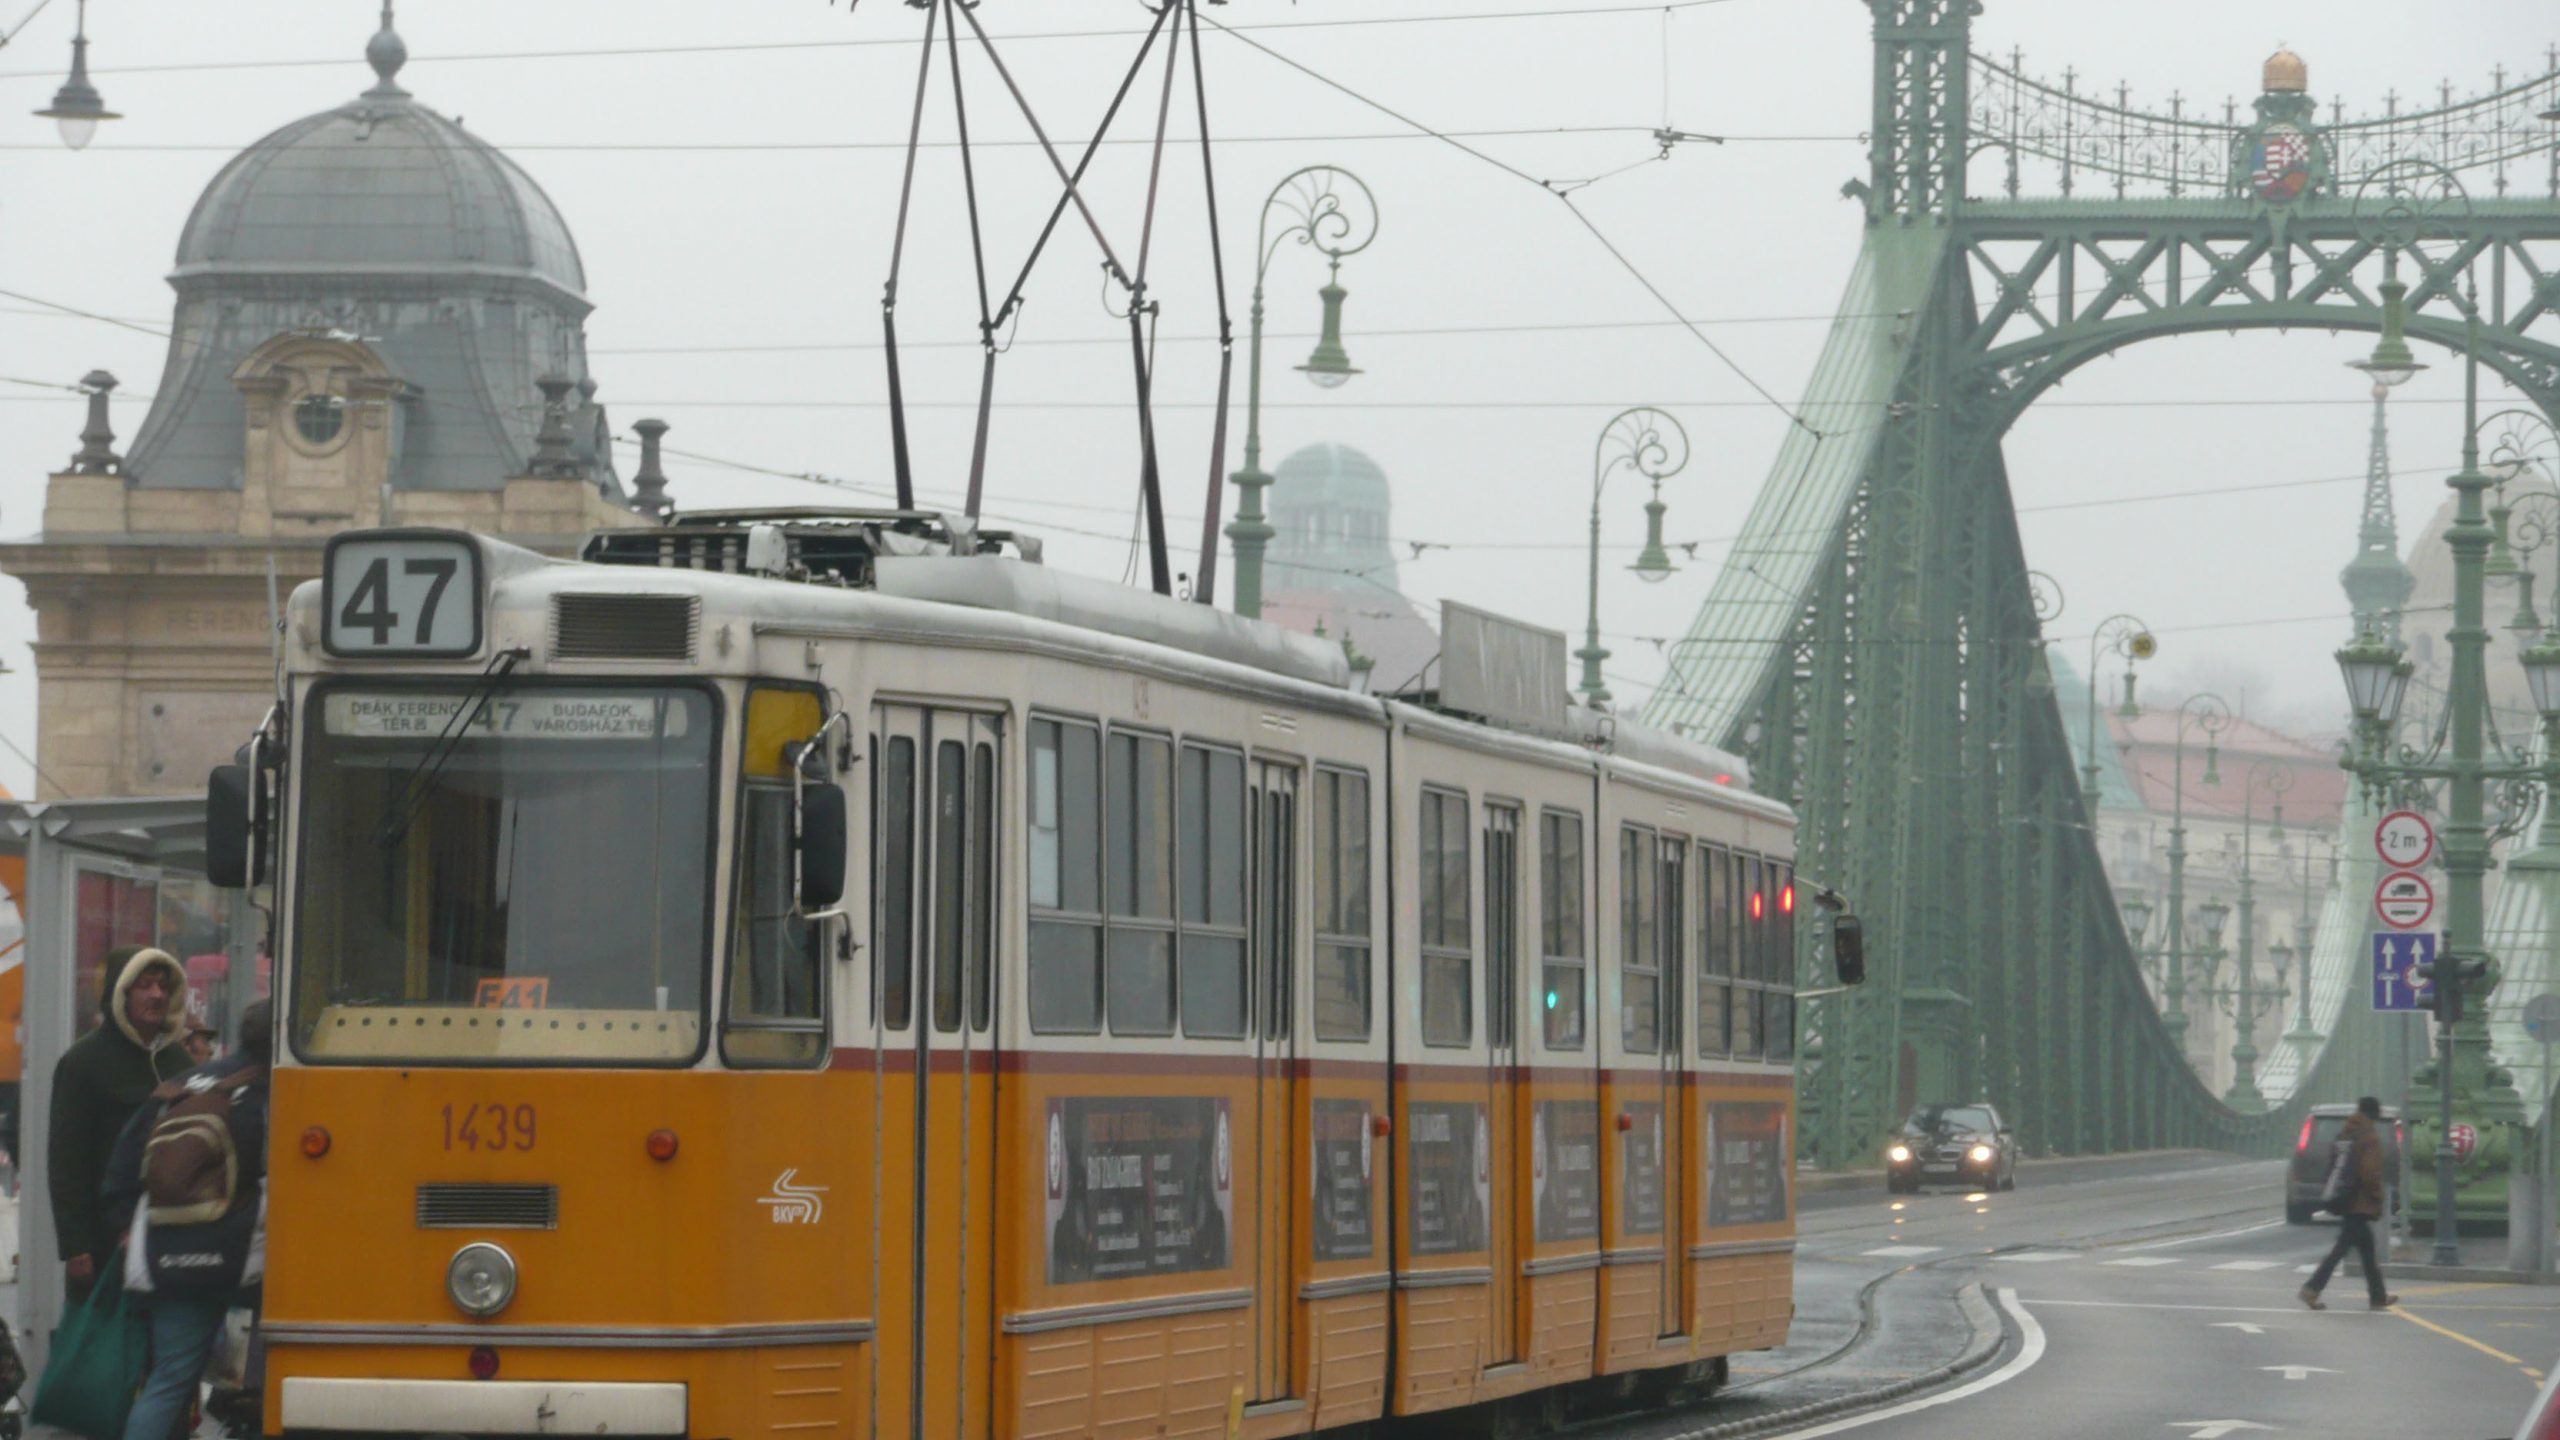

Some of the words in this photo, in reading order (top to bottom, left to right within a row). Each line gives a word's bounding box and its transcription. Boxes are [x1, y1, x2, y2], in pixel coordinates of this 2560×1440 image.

[340, 557, 458, 645] 47
[351, 699, 393, 716] DEÁK
[399, 701, 460, 716] FERENC
[471, 701, 522, 732] 47
[2390, 831, 2398, 848] 2
[2403, 836, 2417, 848] m
[442, 1103, 536, 1152] 1439
